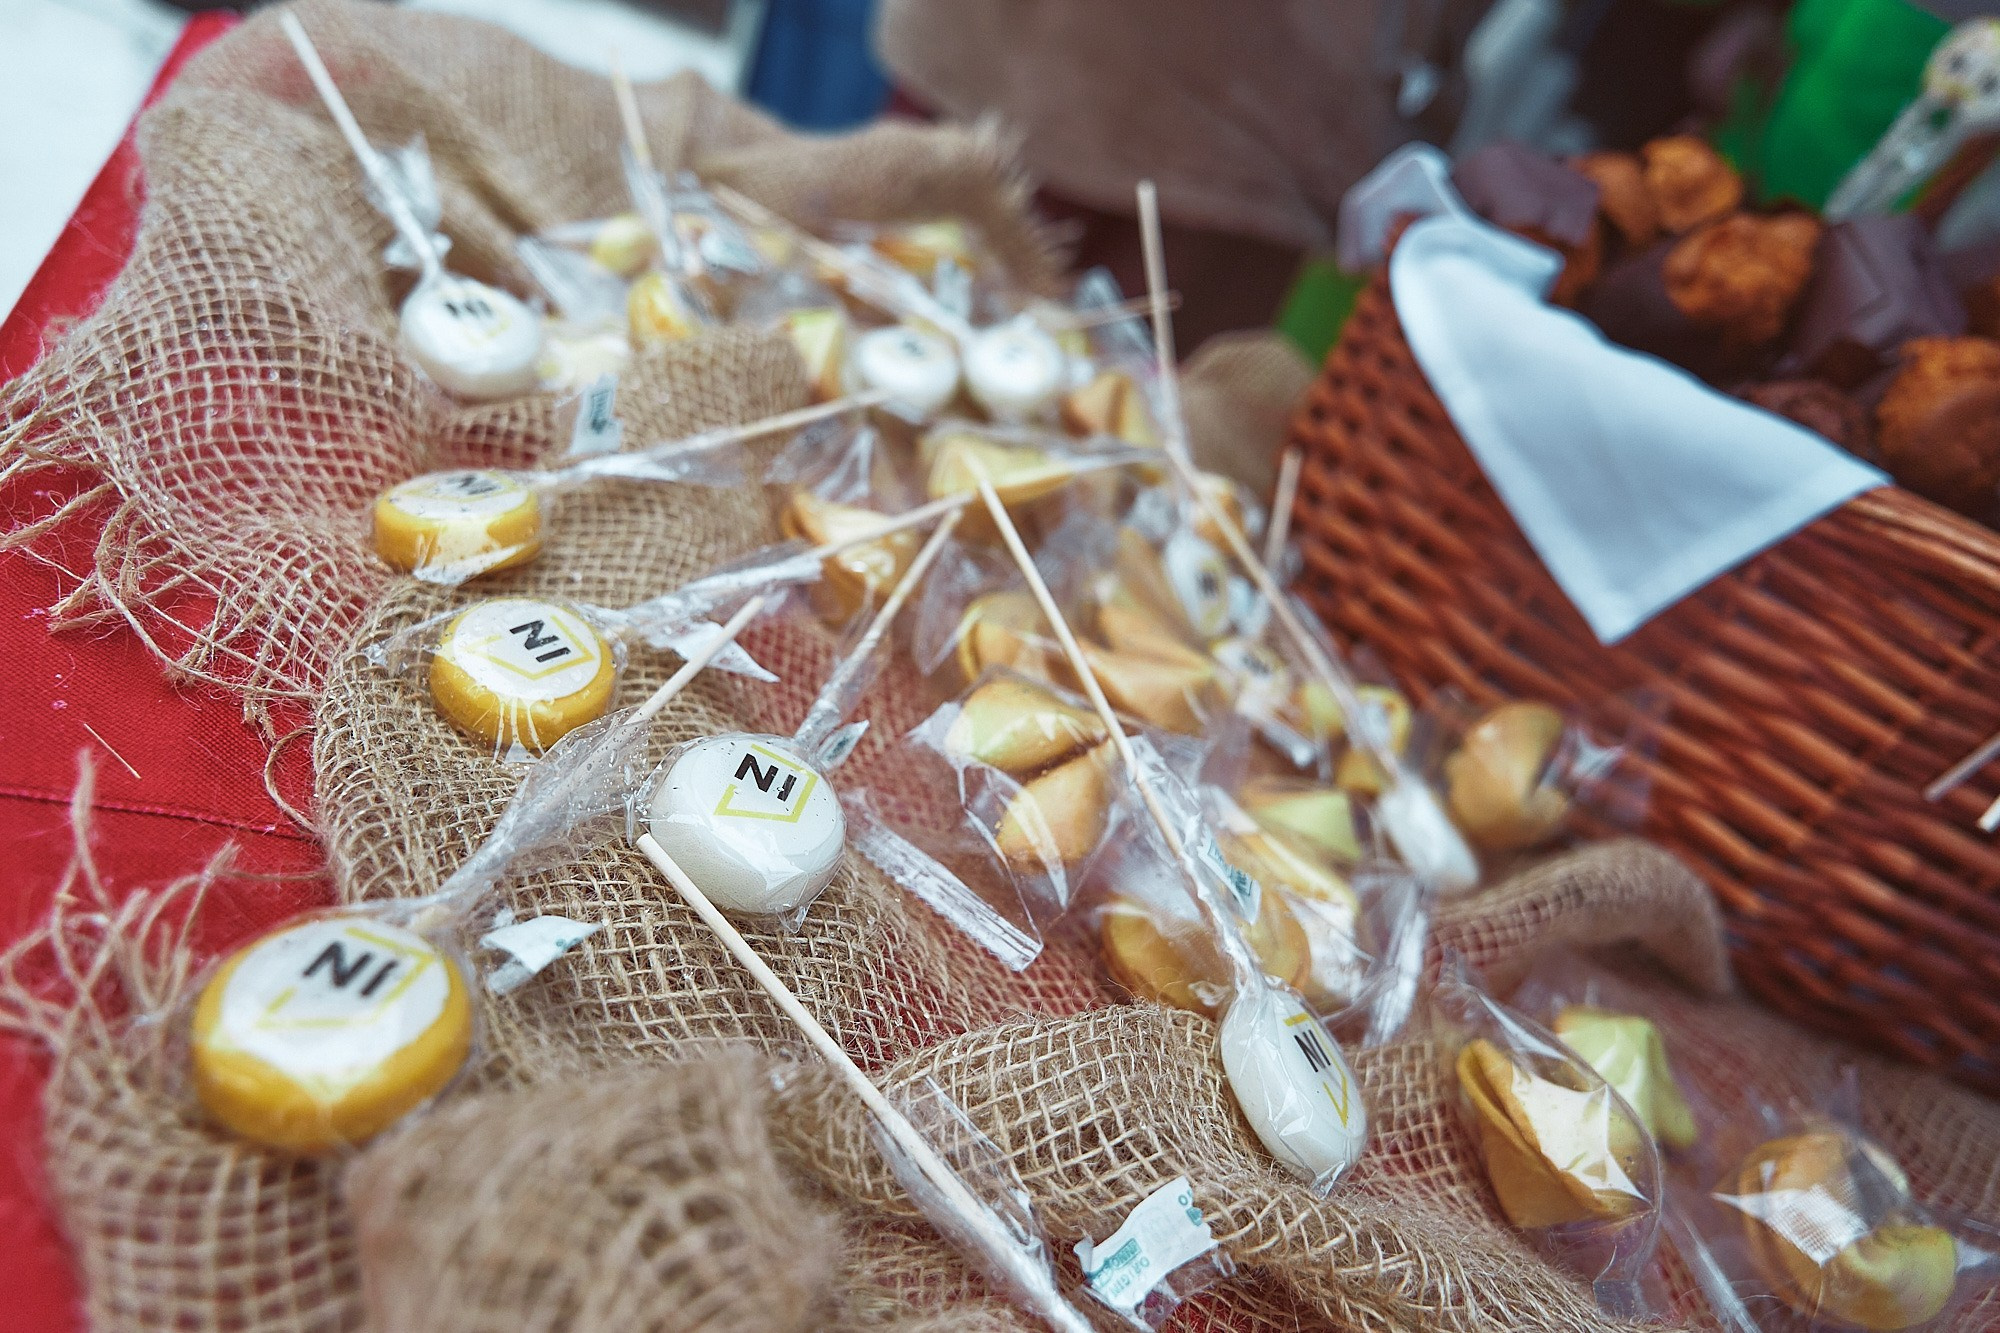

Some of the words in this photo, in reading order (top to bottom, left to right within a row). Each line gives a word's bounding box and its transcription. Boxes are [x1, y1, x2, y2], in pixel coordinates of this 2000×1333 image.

[510, 619, 572, 663] NI
[734, 753, 798, 801] NI
[302, 940, 399, 999] NI
[1294, 1029, 1331, 1073] NI
